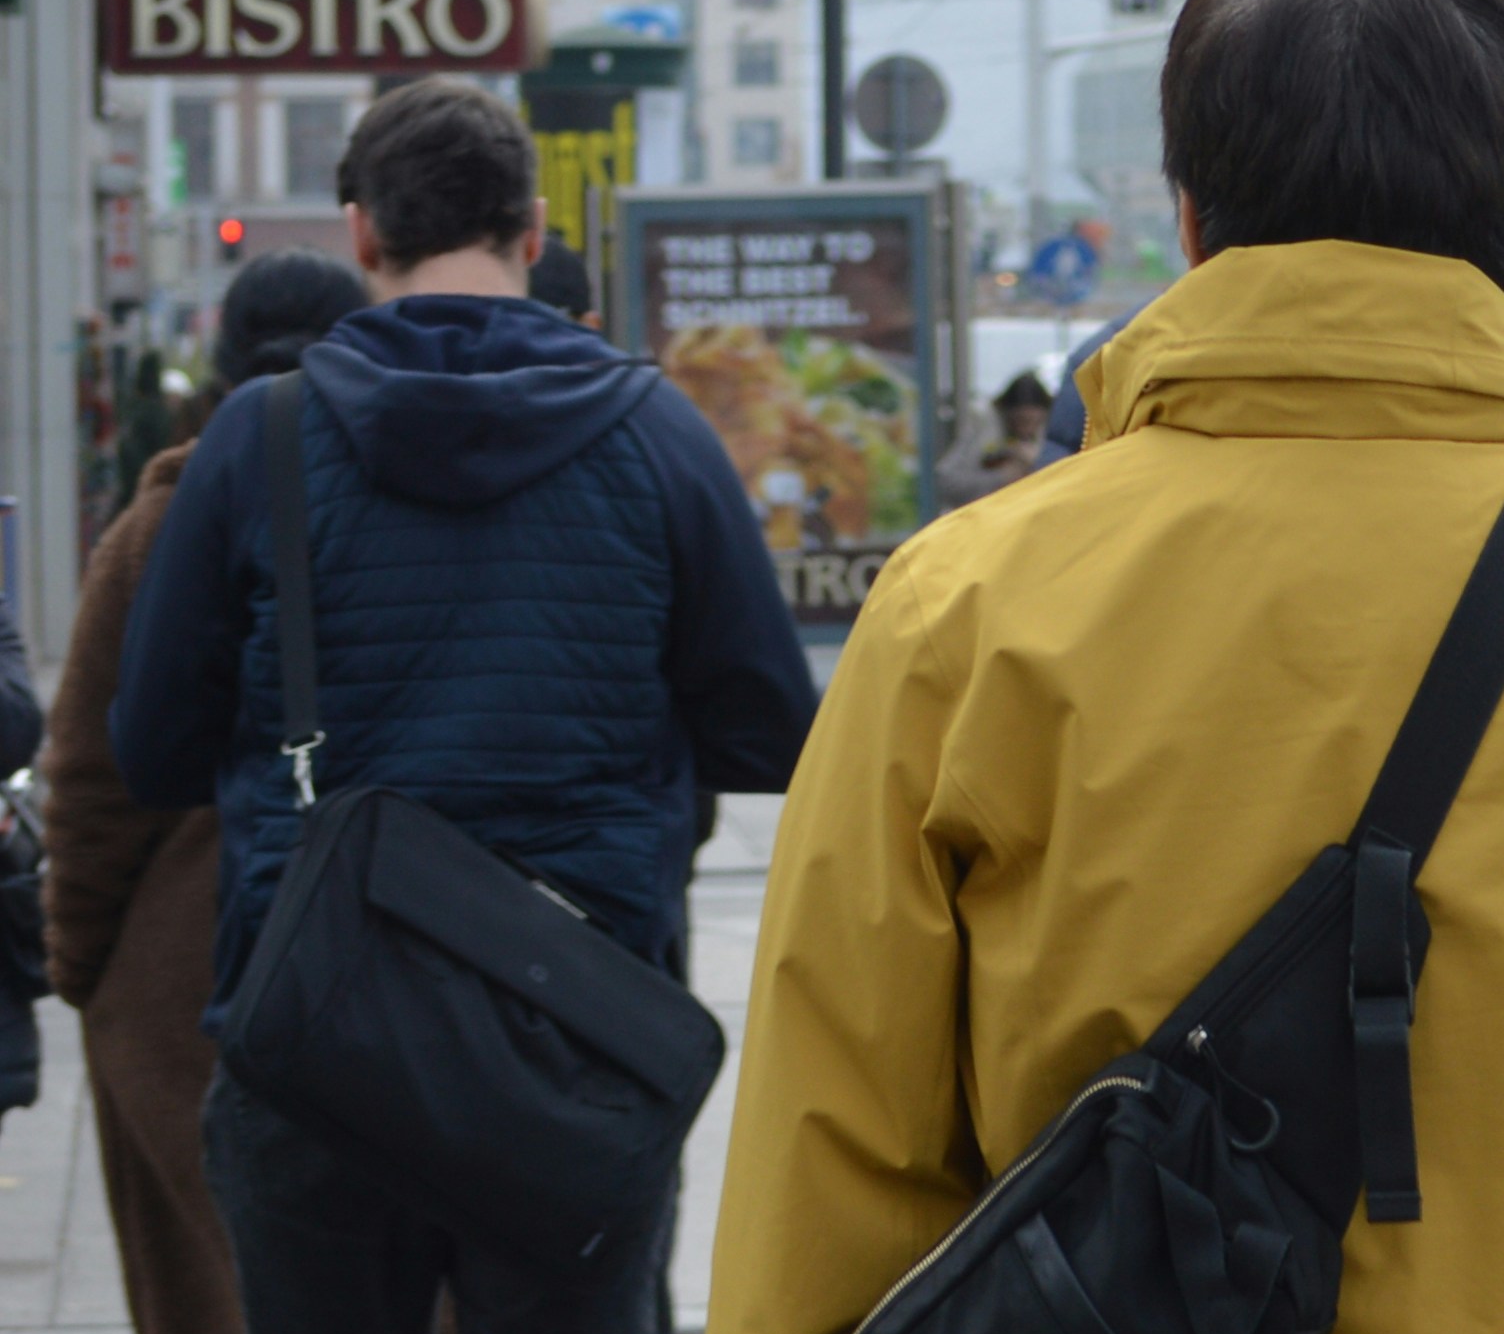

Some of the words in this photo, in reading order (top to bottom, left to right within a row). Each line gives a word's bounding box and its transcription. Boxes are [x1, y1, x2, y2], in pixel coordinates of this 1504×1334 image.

[662, 236, 734, 265] THE
[739, 234, 814, 264] WAY
[824, 231, 874, 263] TO
[662, 268, 734, 297] THE
[740, 265, 834, 295] BEST
[776, 553, 888, 608] TRO
